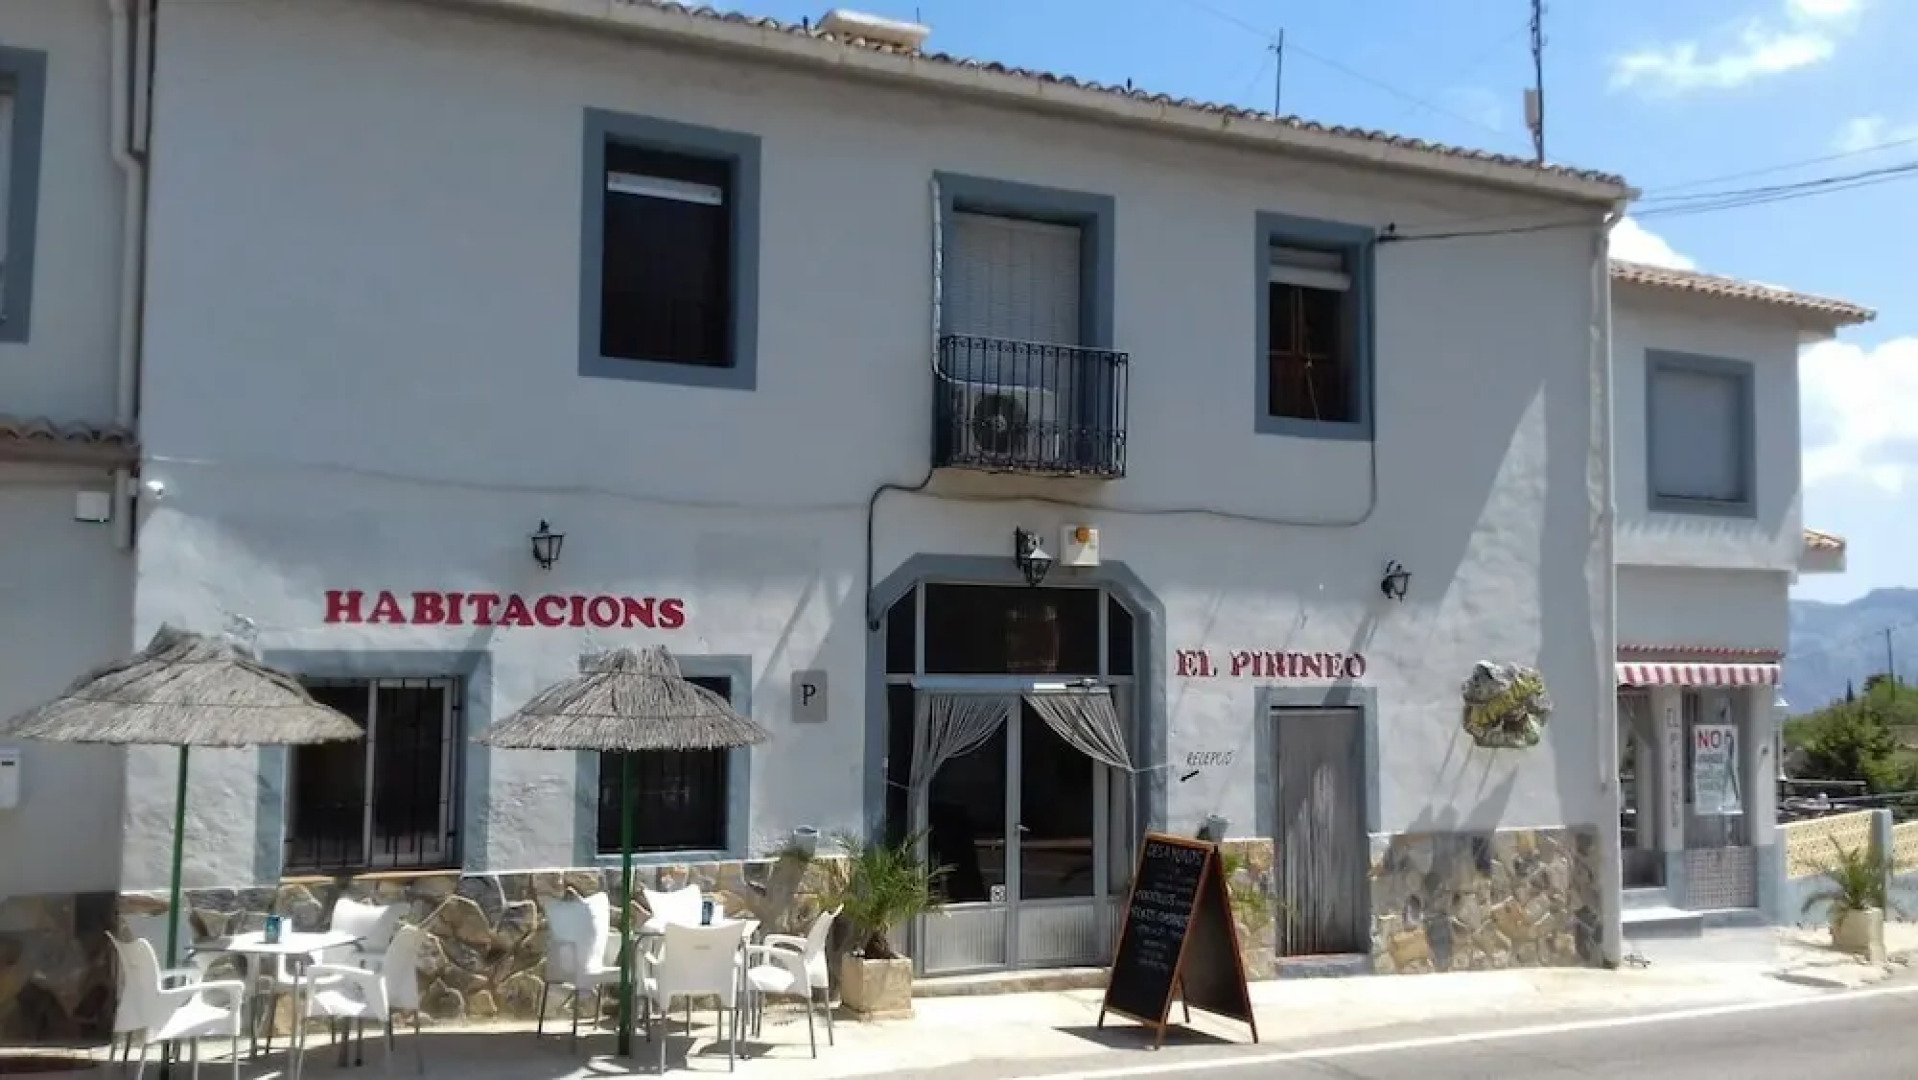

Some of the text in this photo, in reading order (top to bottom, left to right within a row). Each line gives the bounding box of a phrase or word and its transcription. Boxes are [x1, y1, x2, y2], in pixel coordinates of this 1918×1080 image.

[324, 590, 685, 629] HABITACIONS
[1176, 650, 1366, 678] EL PIRINEO
[801, 684, 816, 707] P
